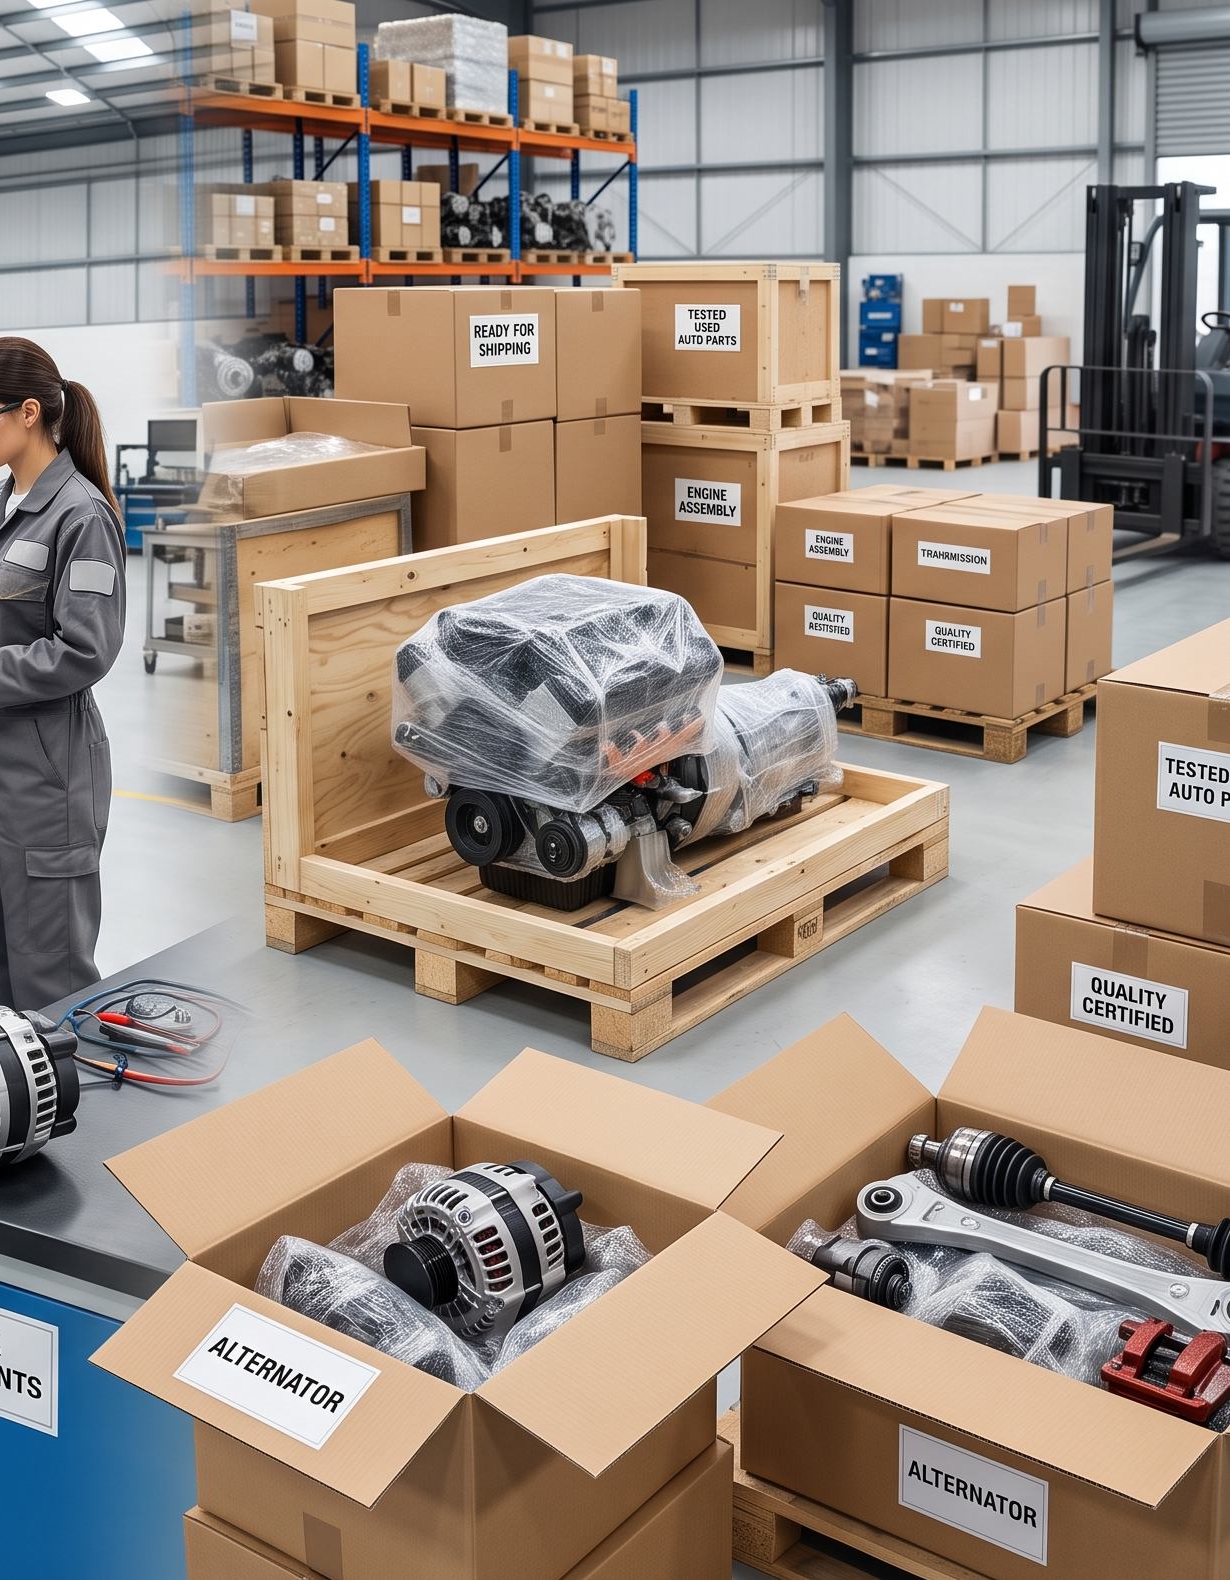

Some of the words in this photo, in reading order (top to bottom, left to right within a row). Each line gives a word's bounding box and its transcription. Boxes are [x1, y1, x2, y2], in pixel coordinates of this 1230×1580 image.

[688, 309, 727, 320] TESTED
[474, 323, 510, 339] READY
[513, 323, 535, 337] FOR
[694, 322, 720, 333] USED
[706, 335, 737, 346] PARTS
[479, 341, 531, 357] SHIPPING
[687, 486, 727, 501] ENGINE
[678, 501, 737, 518] ASSEMBLY
[815, 534, 844, 546] ENGINE
[808, 544, 850, 557] ASSEMBLY
[812, 611, 846, 624] QUALITY
[934, 626, 972, 639] QUALITY
[931, 637, 975, 652] CERTIFIED
[1165, 757, 1230, 784] TESTED
[1169, 782, 1215, 805] AUTO
[1091, 976, 1167, 1010] QUALITY
[1082, 997, 1174, 1035] CERTIFIED
[207, 1336, 345, 1414] ALTERNATOR
[908, 1460, 1037, 1529] ALTERNATOR
